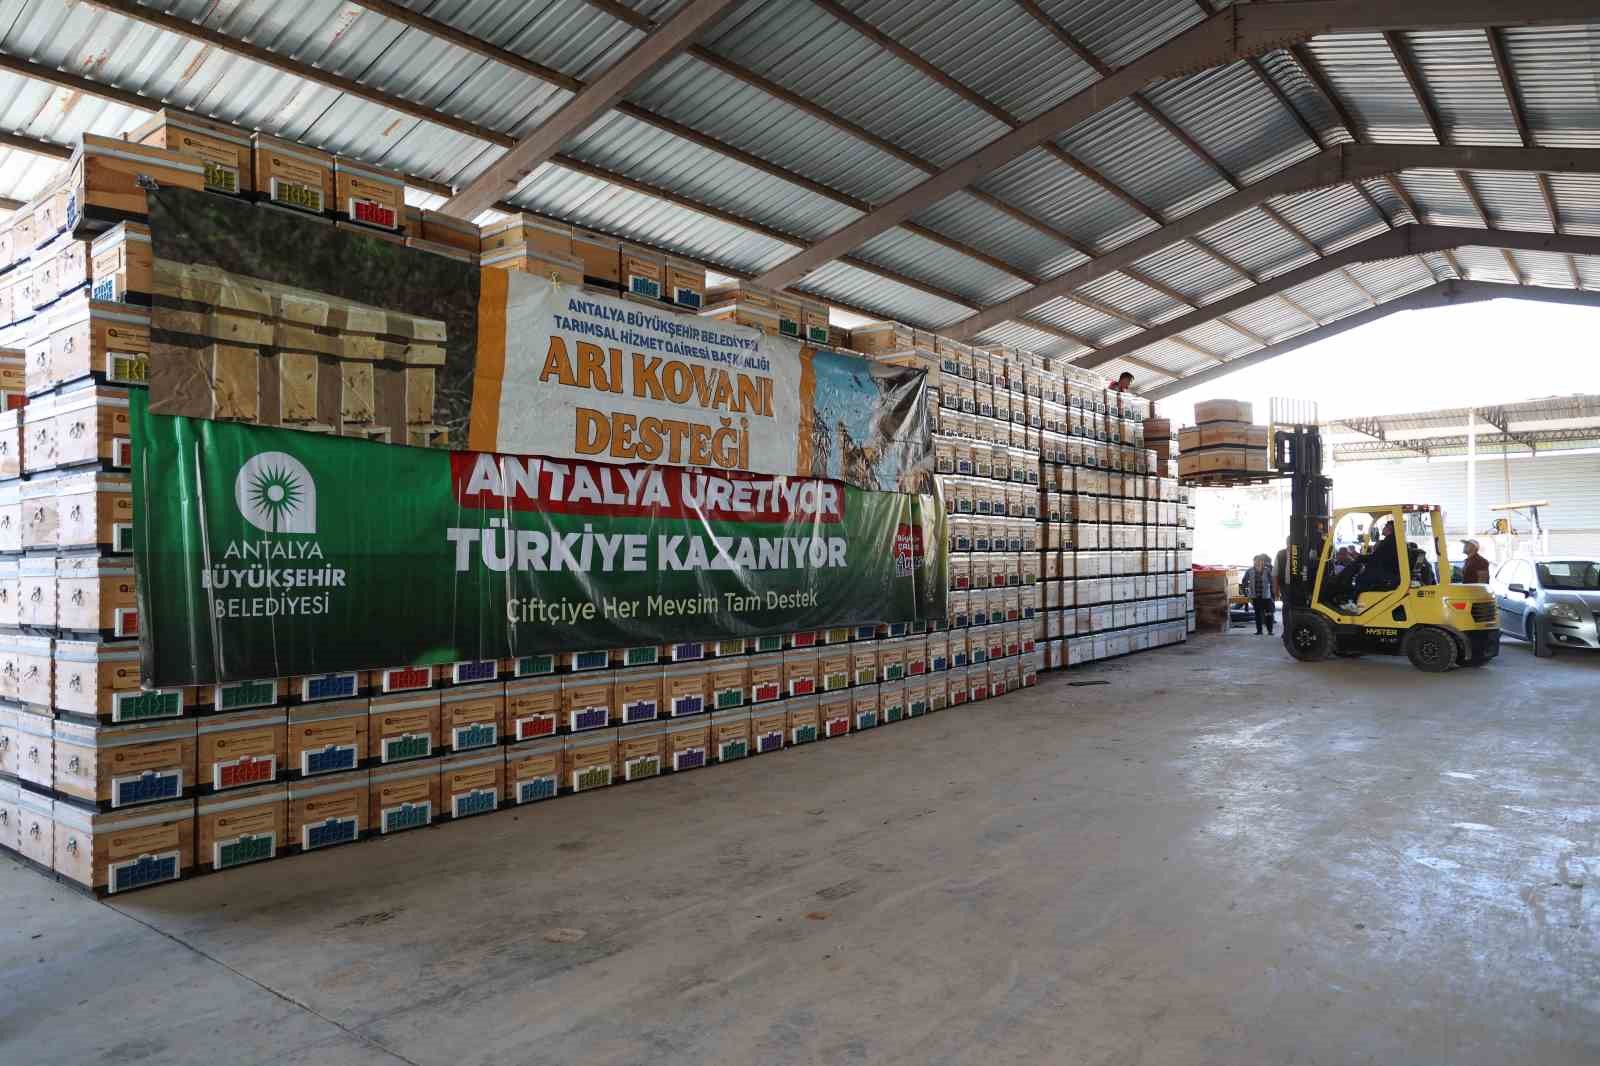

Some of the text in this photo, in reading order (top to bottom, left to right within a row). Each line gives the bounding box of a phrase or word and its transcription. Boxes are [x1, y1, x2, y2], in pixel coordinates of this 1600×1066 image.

[568, 298, 625, 323] ANTALYA
[553, 314, 619, 341] TARIMSAL
[620, 328, 665, 351] HİZMET
[711, 349, 770, 371] BAŞKNLIĞI
[539, 336, 775, 417] ARI KOVANI
[574, 407, 750, 470] DESTEĞİ
[464, 452, 840, 515] ANTALYA ÜRETİYOR
[223, 540, 324, 560] ANTALYA
[447, 517, 848, 573] TÜRKİYE KAZANIYOR
[201, 563, 347, 592] BÜYÜKŞEHİR
[215, 591, 330, 619] BELEDİYESİ
[506, 588, 818, 625] Çiftçiye Her Mevsim Tam Destek
